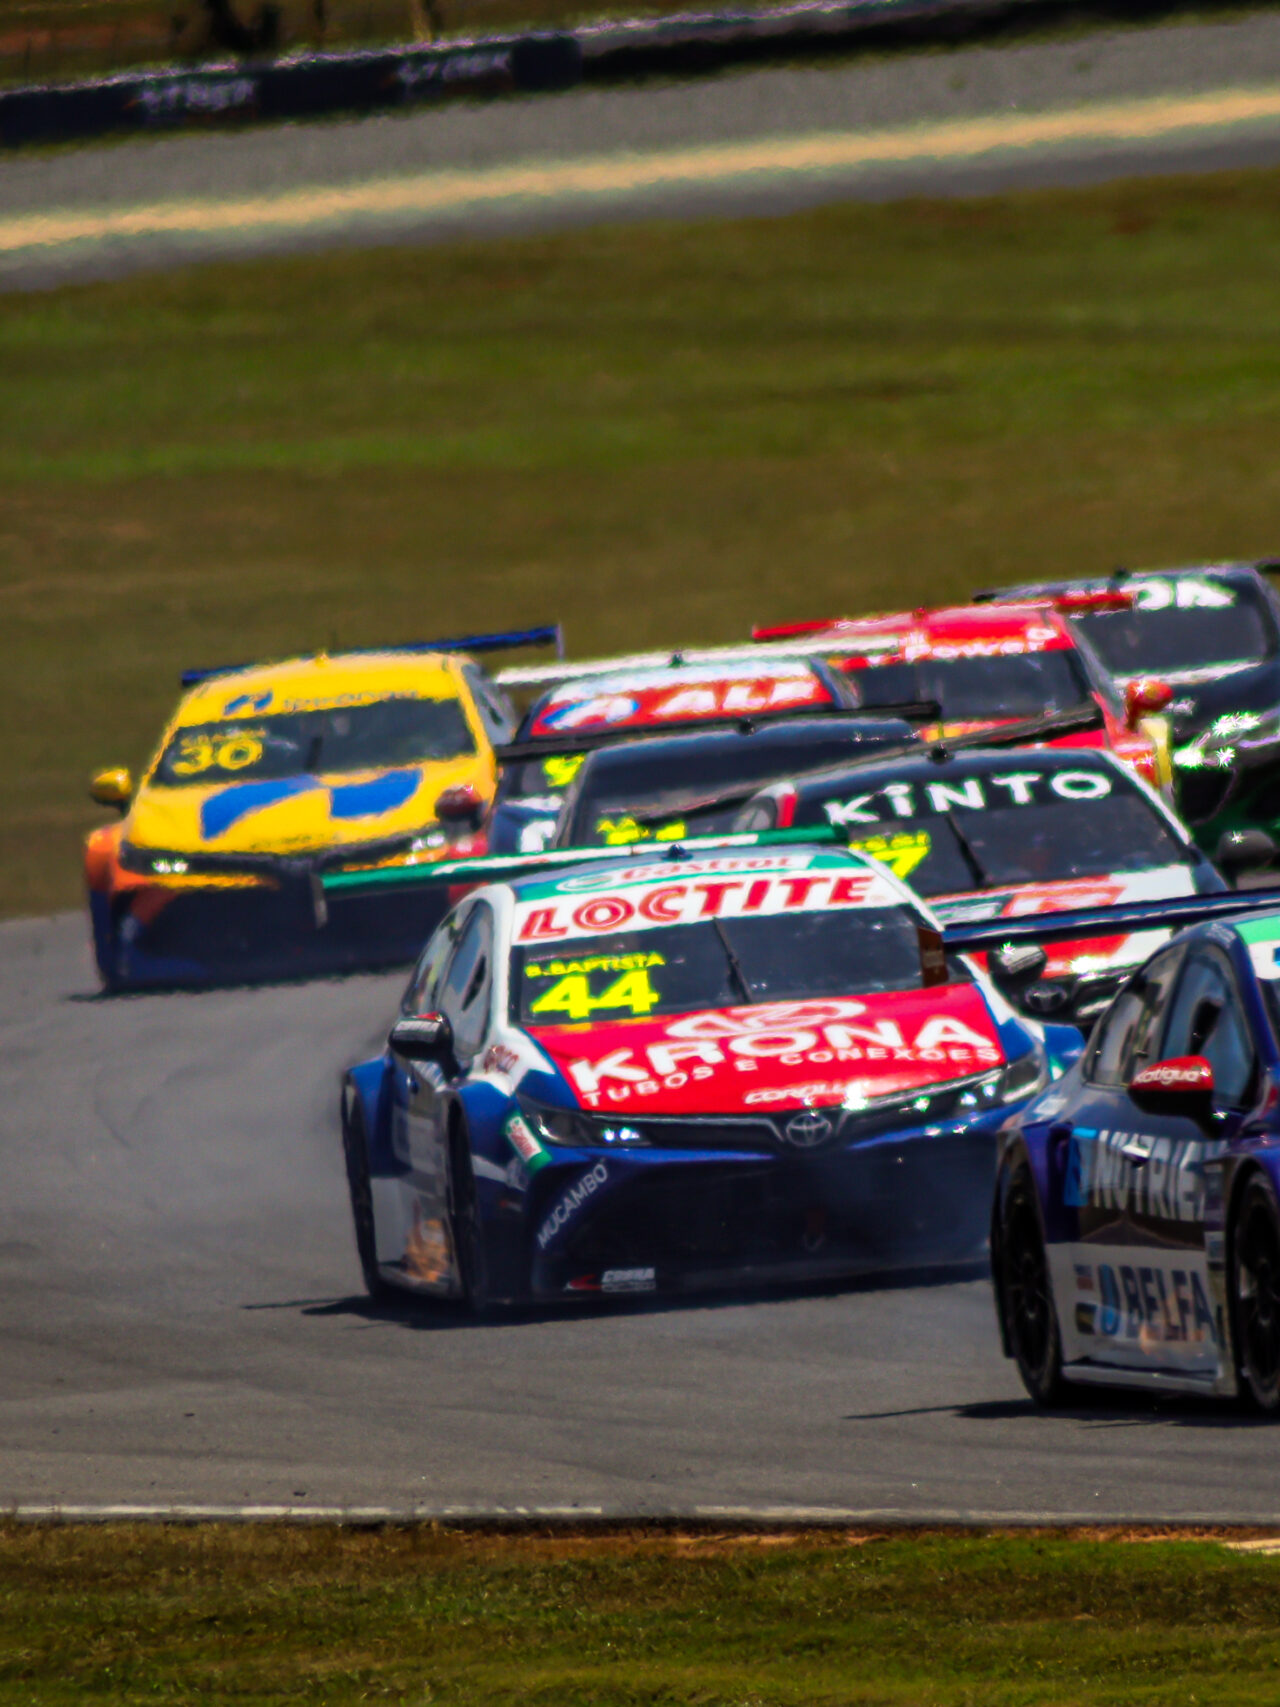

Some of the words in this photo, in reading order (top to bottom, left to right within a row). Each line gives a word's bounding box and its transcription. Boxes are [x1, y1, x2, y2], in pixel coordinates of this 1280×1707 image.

[172, 740, 263, 776] 30
[517, 876, 875, 942] LOCTITE
[531, 970, 660, 1019] 44
[569, 1016, 994, 1092] KRONA
[581, 1065, 715, 1107] TUBOS
[736, 1059, 759, 1073] E
[743, 1082, 860, 1105] COROLL
[537, 1162, 608, 1249] MUCAMBO
